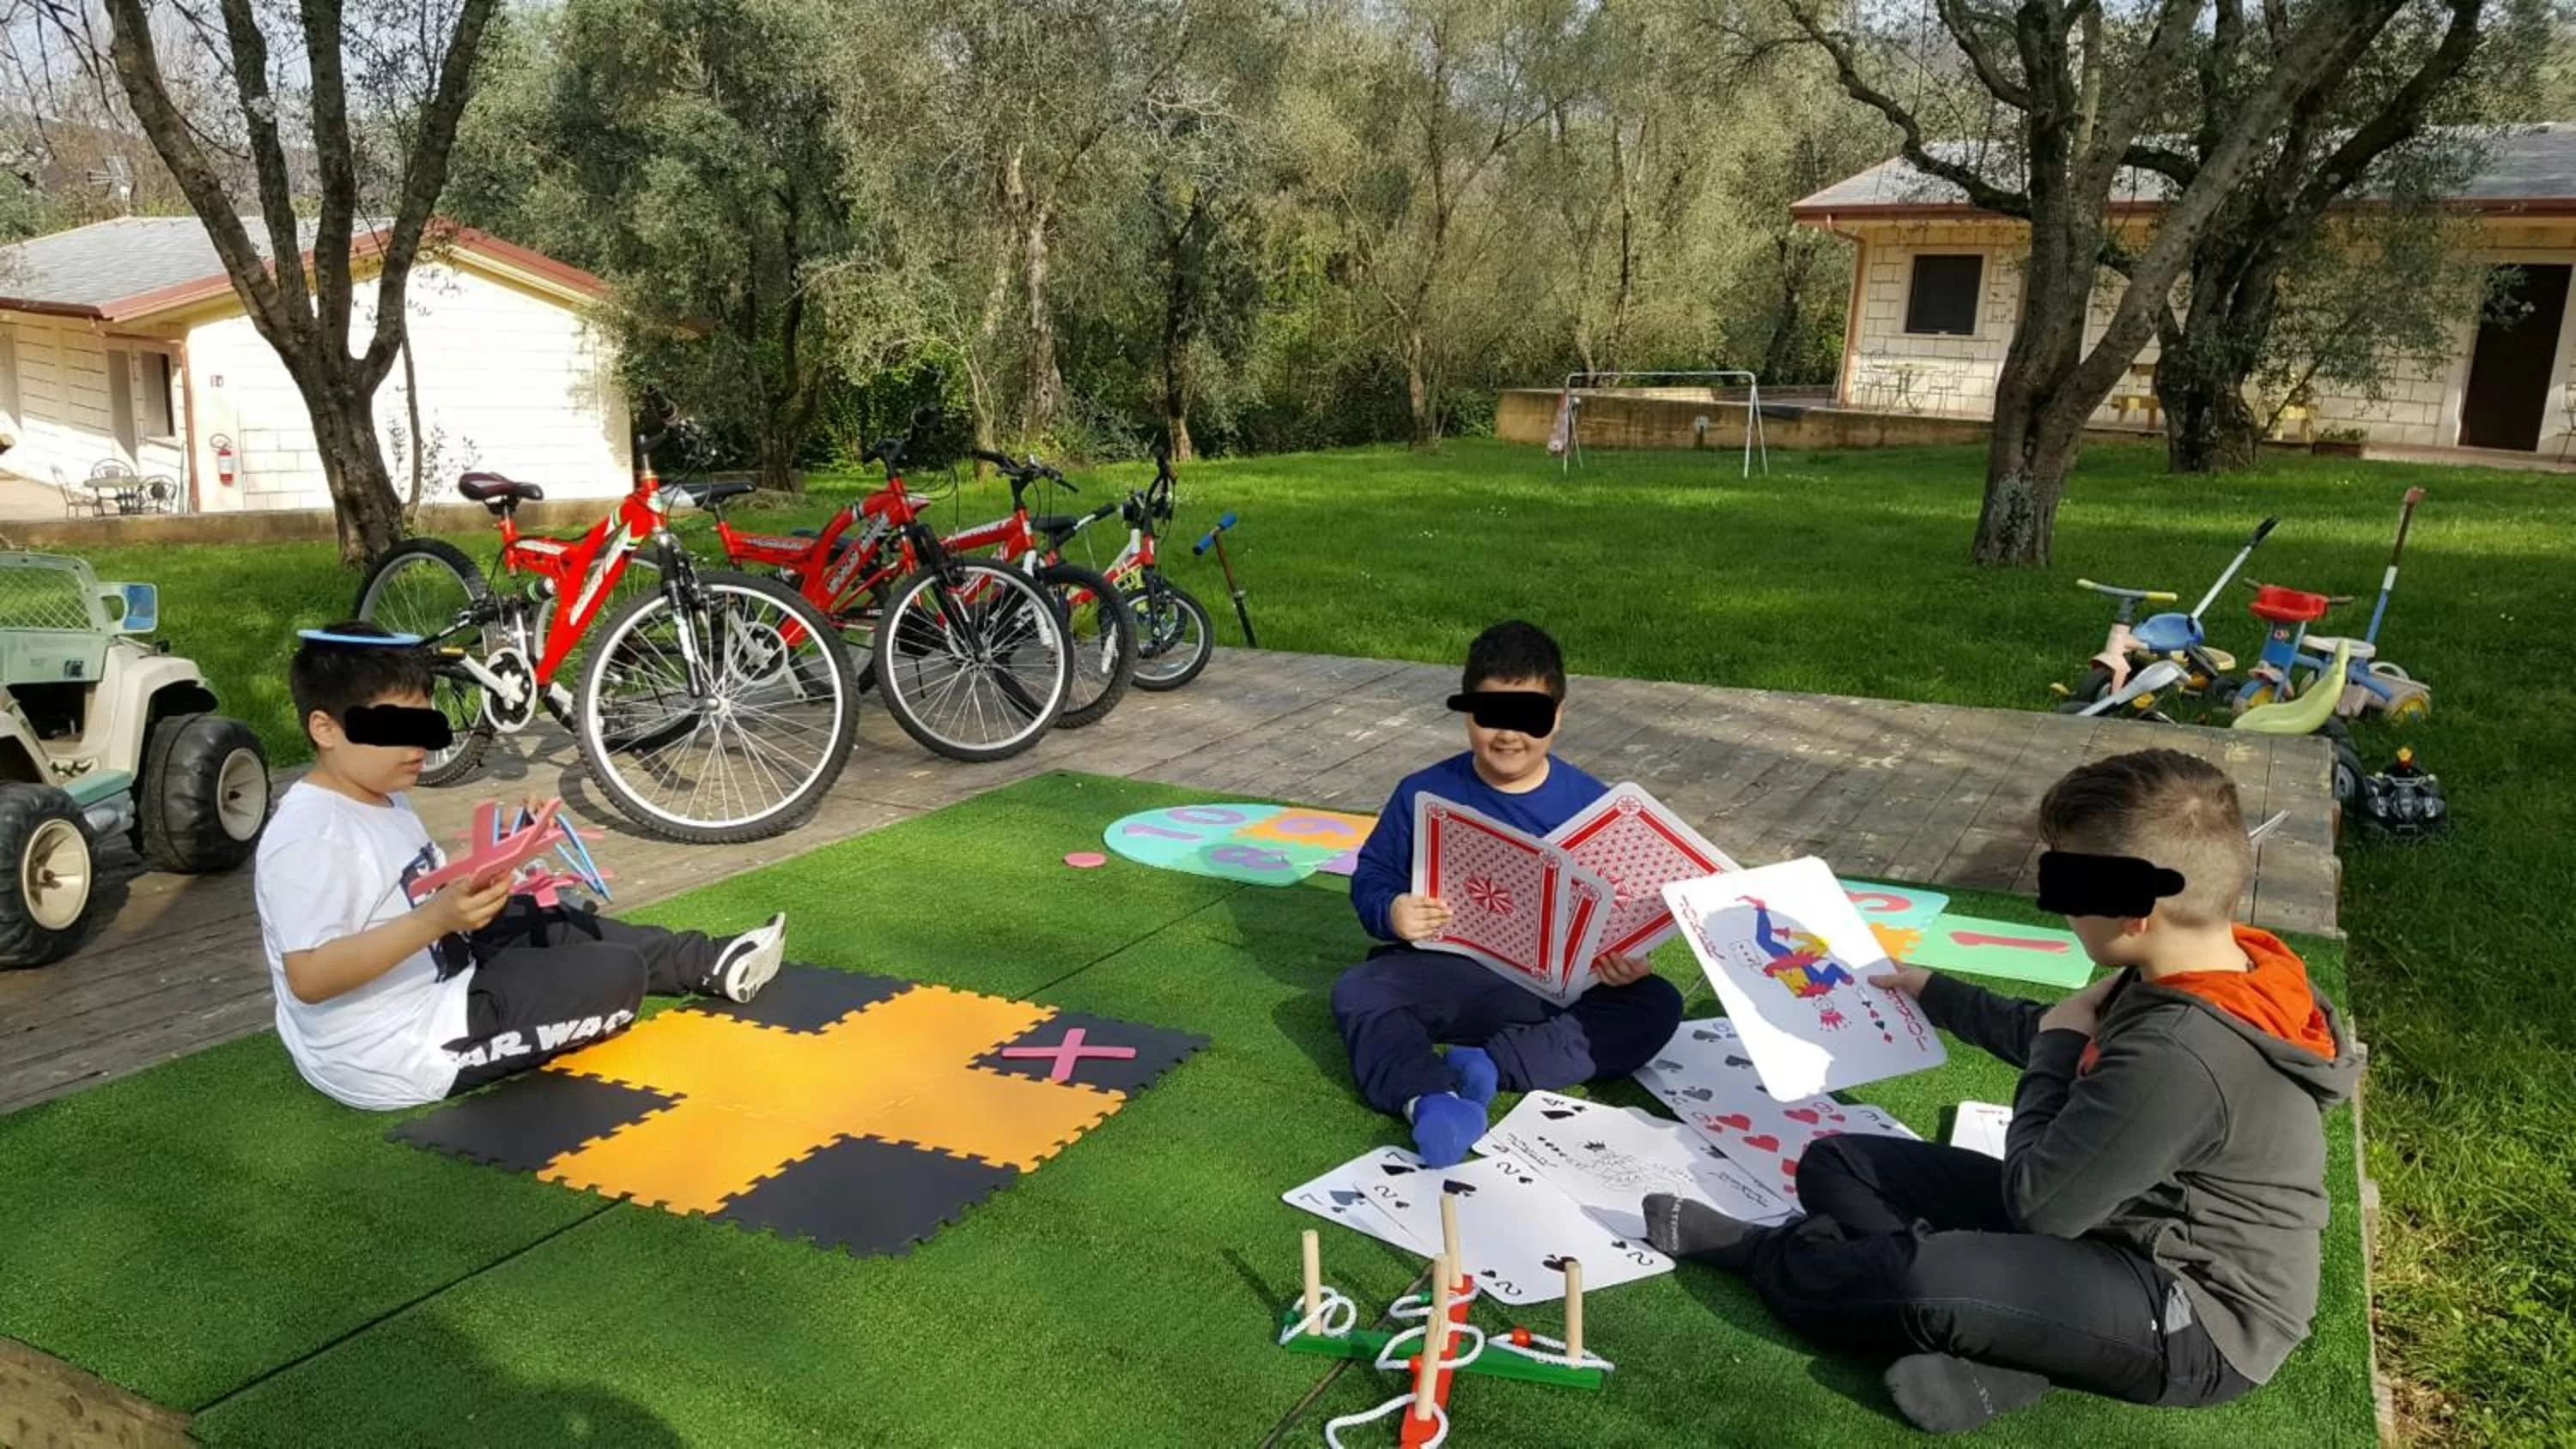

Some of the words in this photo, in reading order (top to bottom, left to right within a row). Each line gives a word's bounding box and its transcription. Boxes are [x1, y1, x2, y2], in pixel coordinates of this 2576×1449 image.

[1211, 845, 1292, 871] 8
[1679, 894, 1727, 960] JOKER
[535, 1009, 635, 1052] WAR
[1385, 1151, 1409, 1164] 7
[1496, 1161, 1522, 1176] 2
[1297, 1191, 1323, 1206] 7
[1374, 1185, 1399, 1198] 2
[1625, 1251, 1655, 1266] 2
[1494, 1280, 1523, 1296] 2
